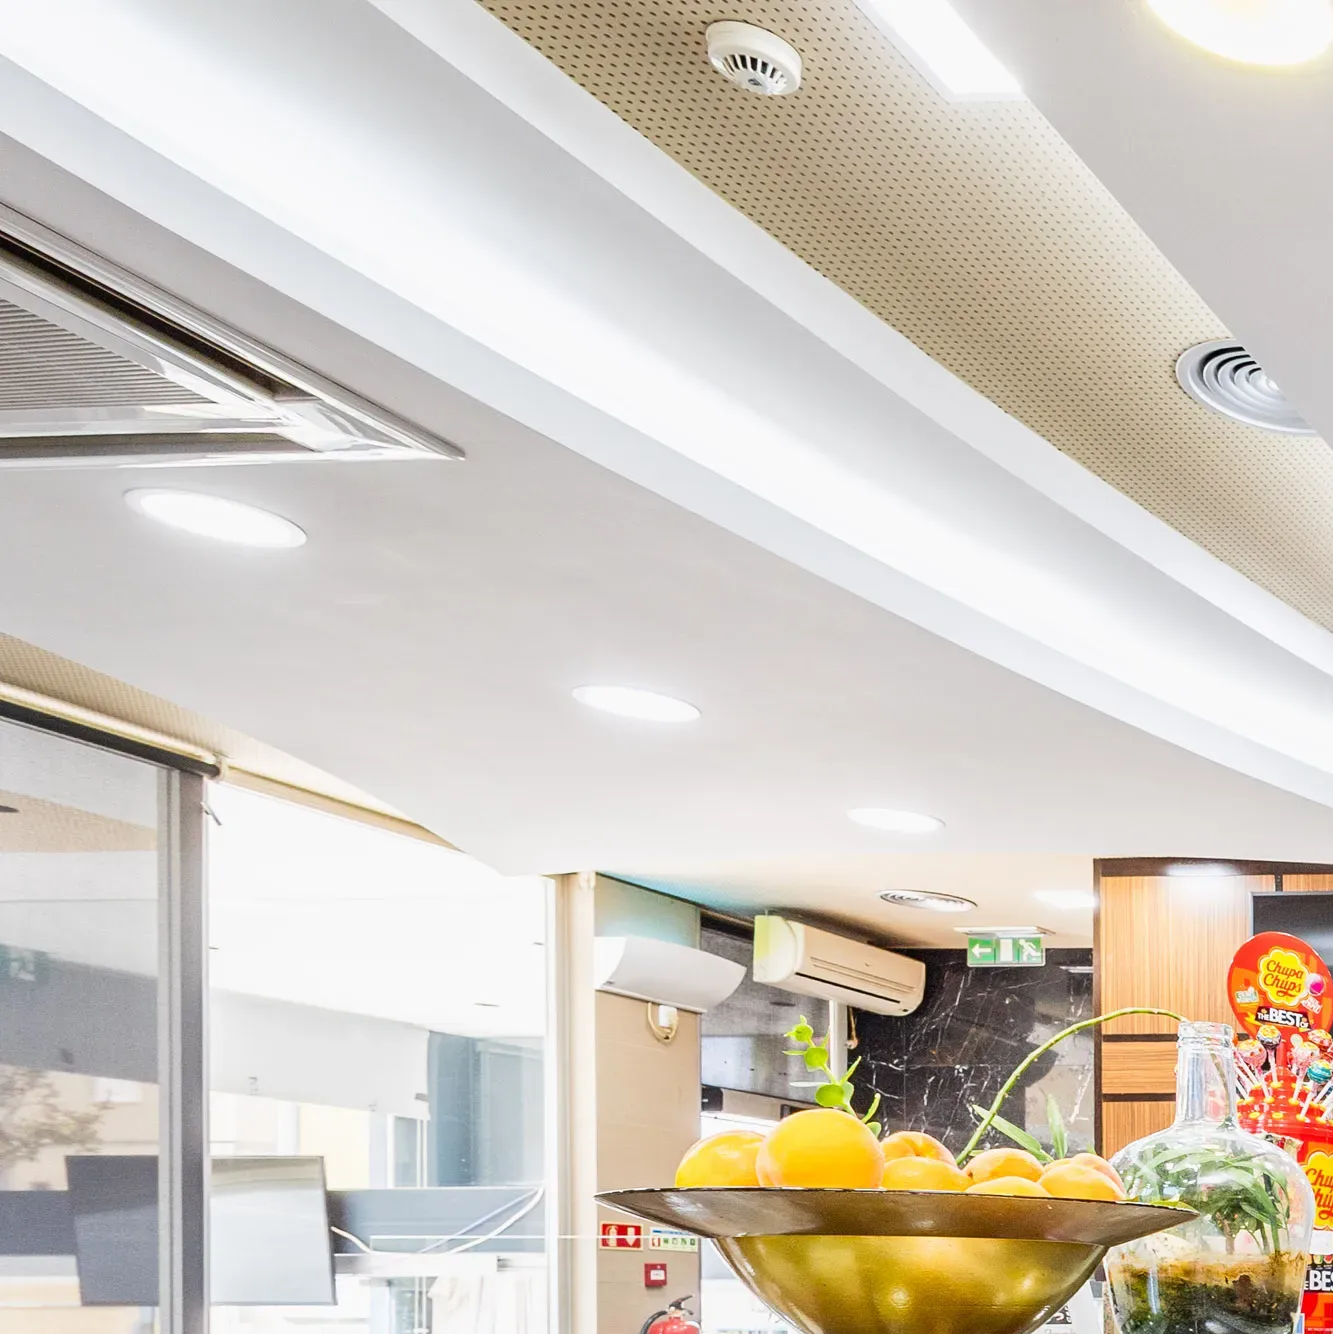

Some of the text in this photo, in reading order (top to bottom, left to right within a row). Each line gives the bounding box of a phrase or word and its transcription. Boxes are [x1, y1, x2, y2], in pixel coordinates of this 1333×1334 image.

[1266, 959, 1304, 980] Chupa
[1263, 973, 1302, 993] Chups
[1257, 1012, 1270, 1021] THE
[1268, 1008, 1303, 1028] BEST
